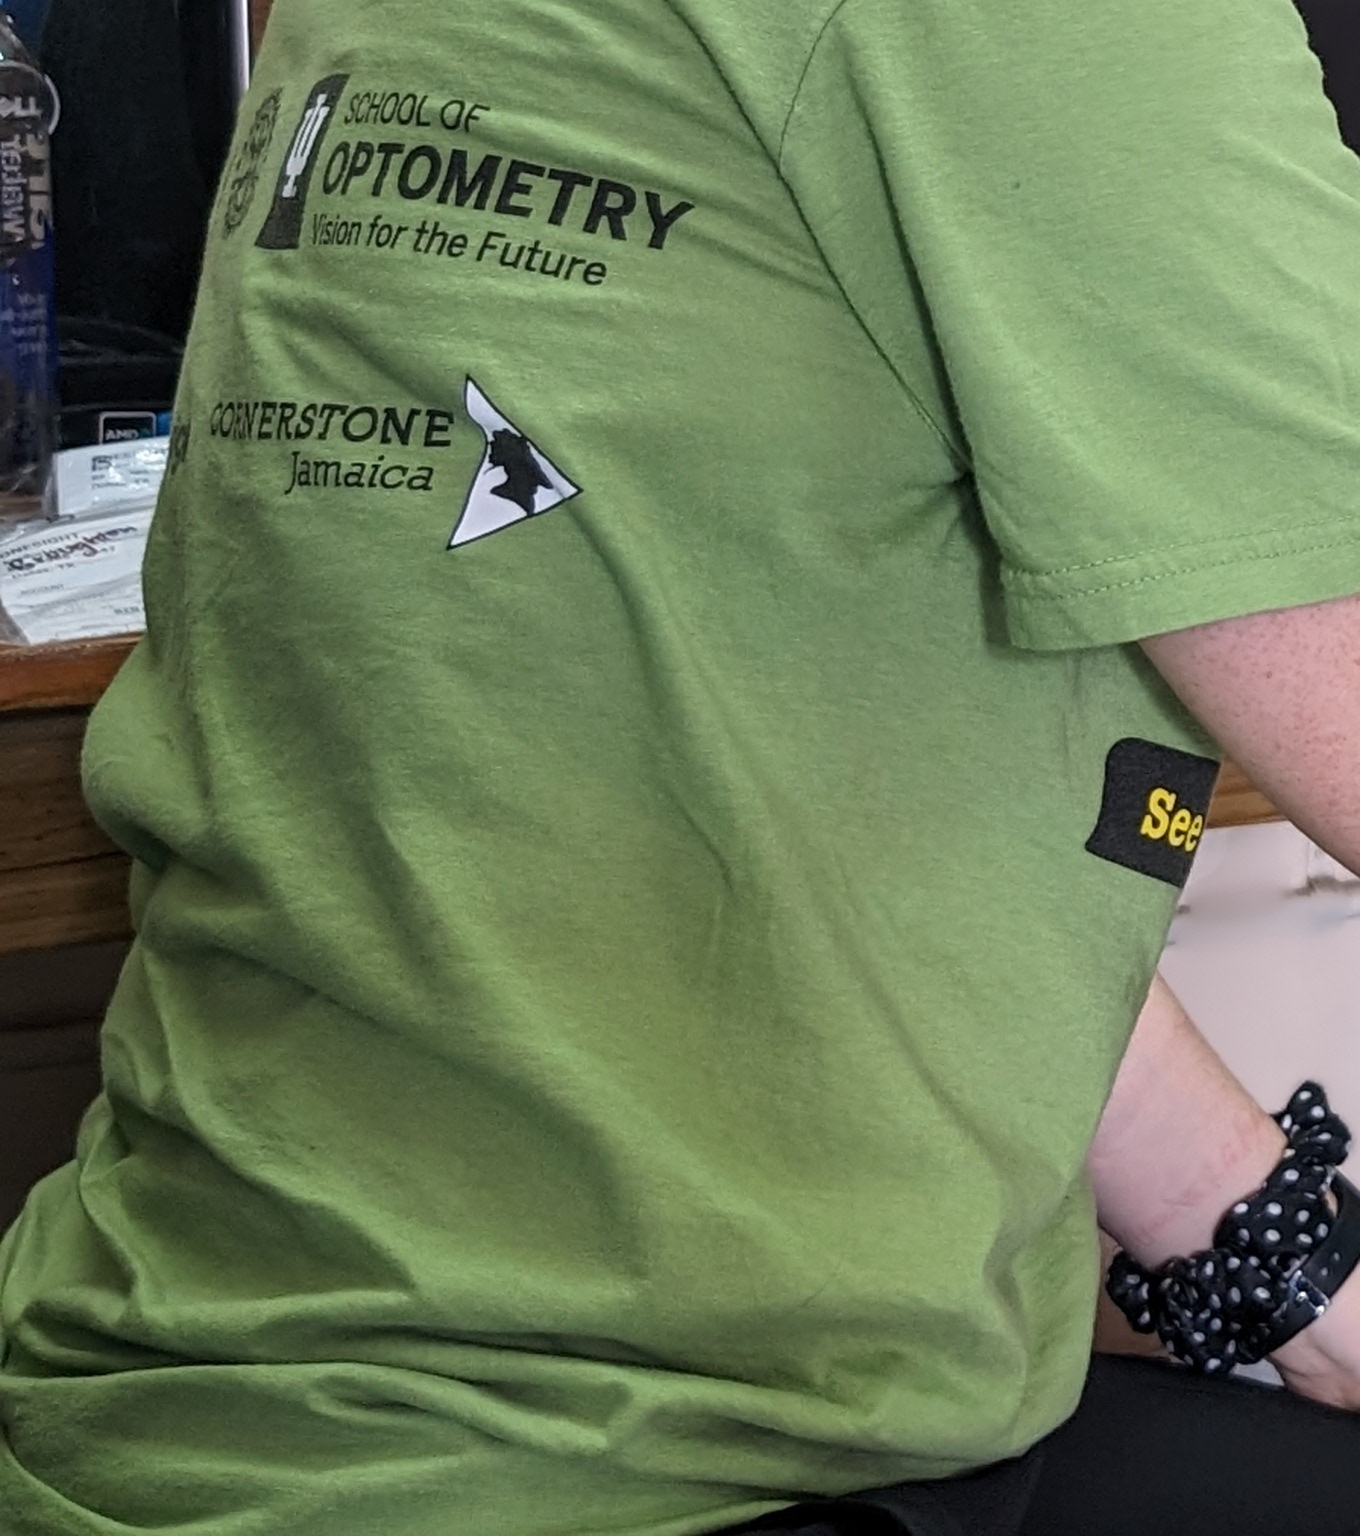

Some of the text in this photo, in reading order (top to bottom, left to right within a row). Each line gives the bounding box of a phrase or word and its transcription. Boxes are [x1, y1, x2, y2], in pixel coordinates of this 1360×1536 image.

[344, 92, 490, 133] SCHOOL OF
[322, 141, 695, 250] OPTOMETRY
[311, 213, 608, 286] Vision for the Future
[210, 401, 454, 447] CORNERSTONE
[284, 451, 433, 495] Jamaica
